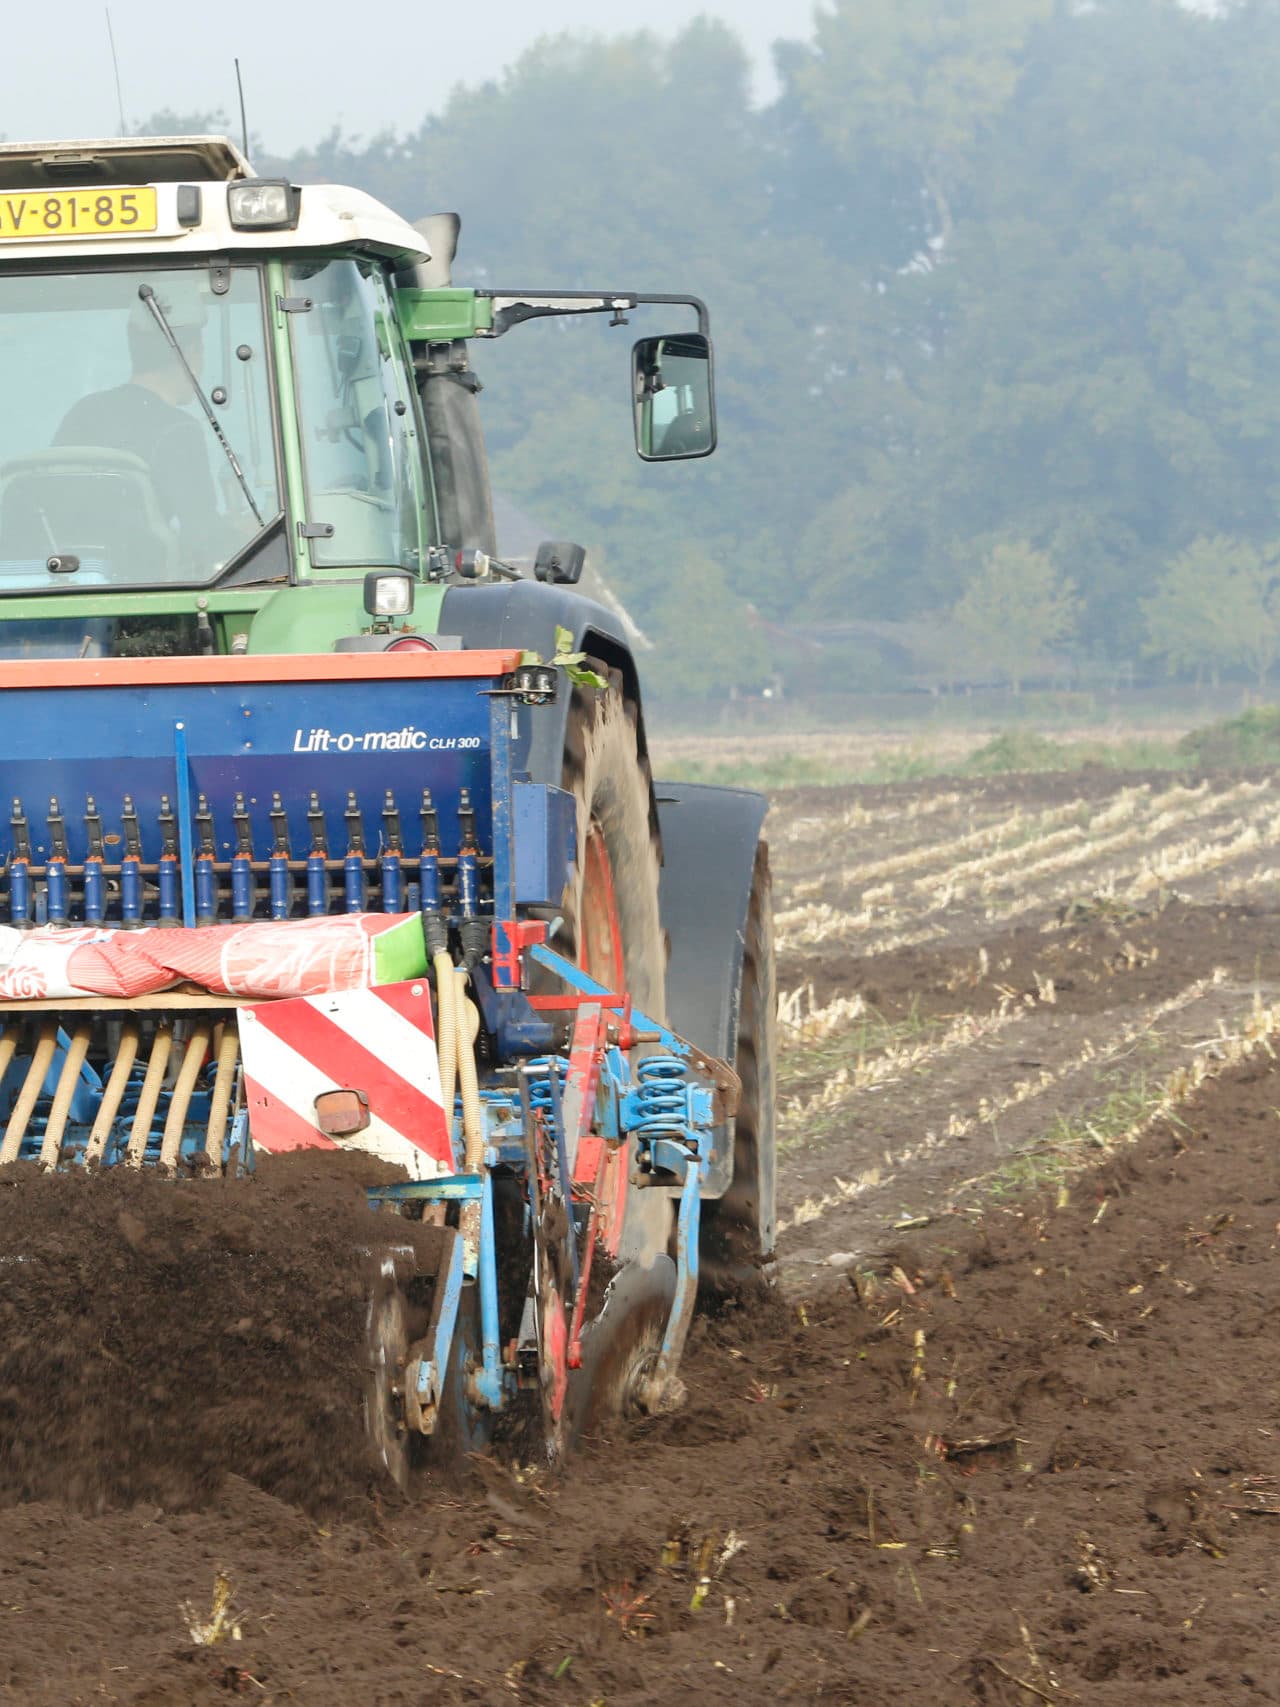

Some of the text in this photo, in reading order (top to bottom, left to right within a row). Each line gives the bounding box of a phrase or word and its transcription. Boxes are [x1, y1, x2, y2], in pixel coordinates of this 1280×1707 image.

[293, 727, 481, 752] Lift-o-matic CLH 300
[12, 979, 32, 997] LG
